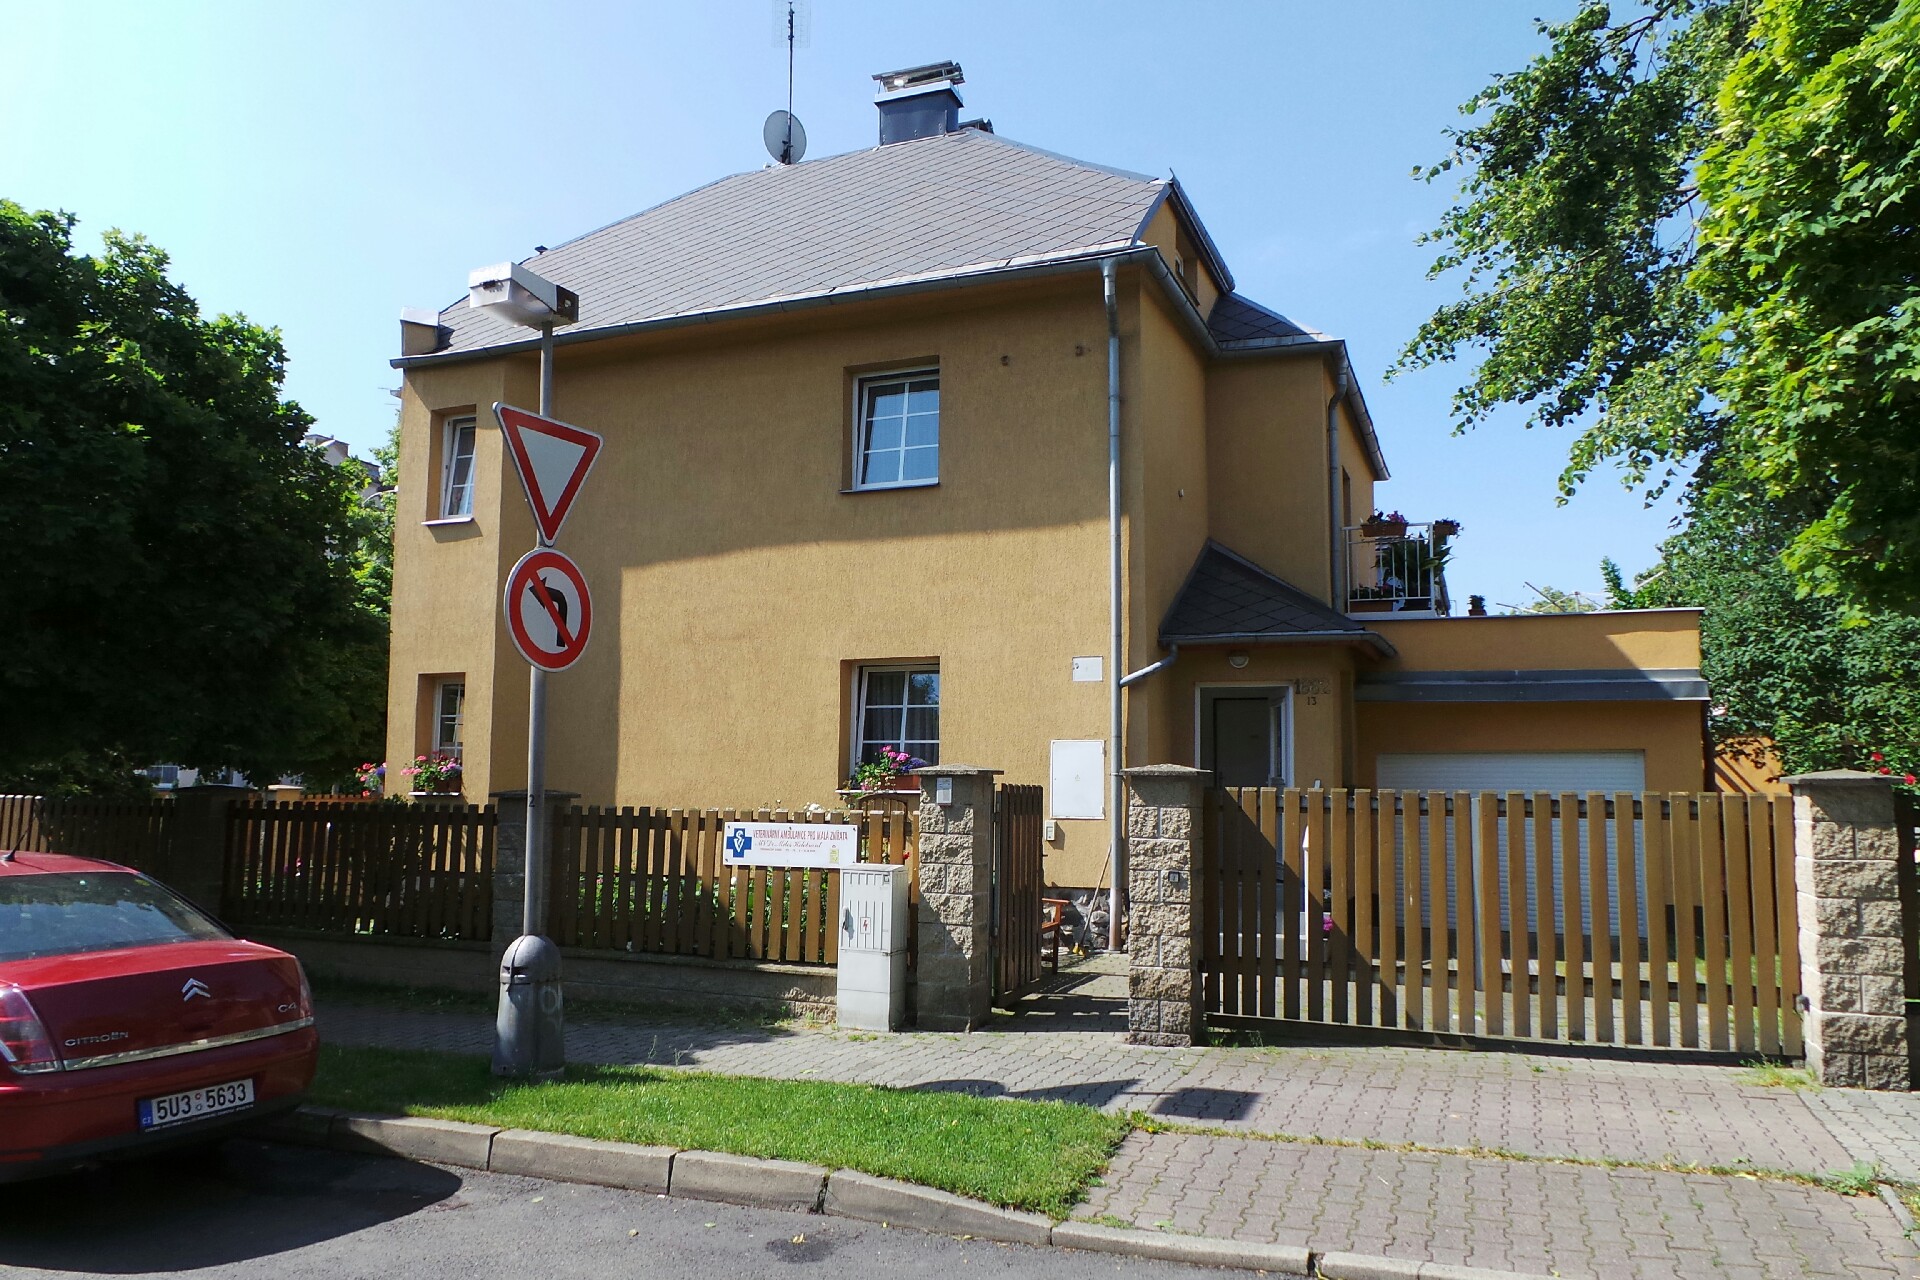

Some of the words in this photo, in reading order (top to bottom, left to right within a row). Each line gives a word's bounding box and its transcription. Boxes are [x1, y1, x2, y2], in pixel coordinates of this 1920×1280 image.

[1307, 696, 1317, 705] 13
[529, 793, 536, 807] 2
[278, 1001, 297, 1013] C4
[157, 1095, 191, 1120] 5U3
[206, 1083, 247, 1109] 5633
[143, 1116, 152, 1125] CZ
